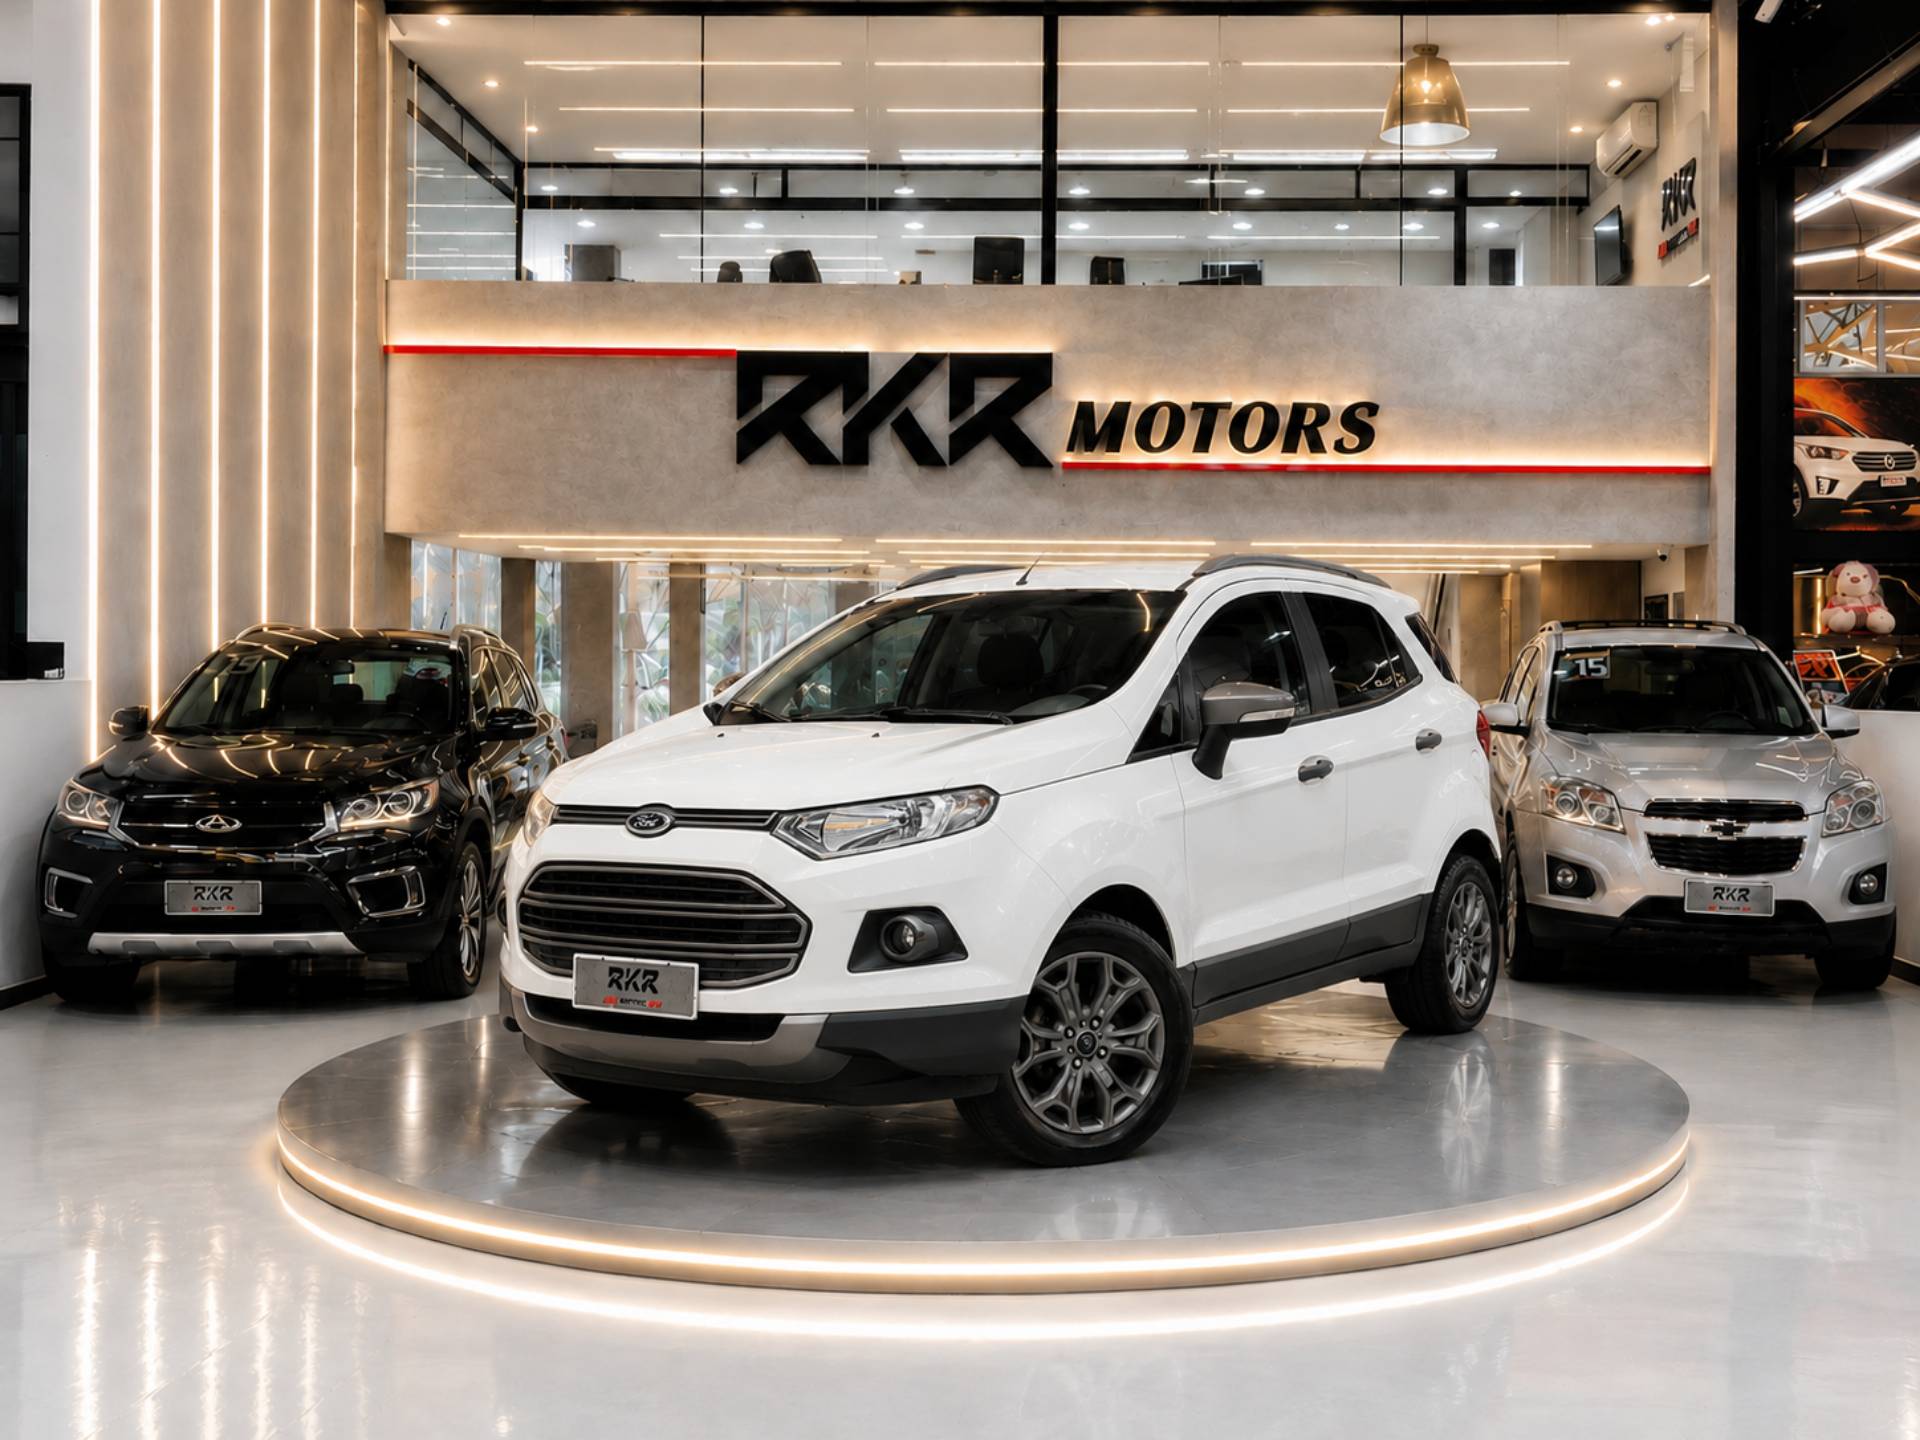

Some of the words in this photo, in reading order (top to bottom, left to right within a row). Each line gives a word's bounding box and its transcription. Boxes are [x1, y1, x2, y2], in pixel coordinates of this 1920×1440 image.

[736, 351, 1053, 468] RKR
[1066, 400, 1380, 455] MOTORS
[1575, 657, 1608, 677] 15
[194, 886, 233, 901] RKR
[1712, 886, 1750, 902] RKR
[607, 966, 659, 994] RKR
